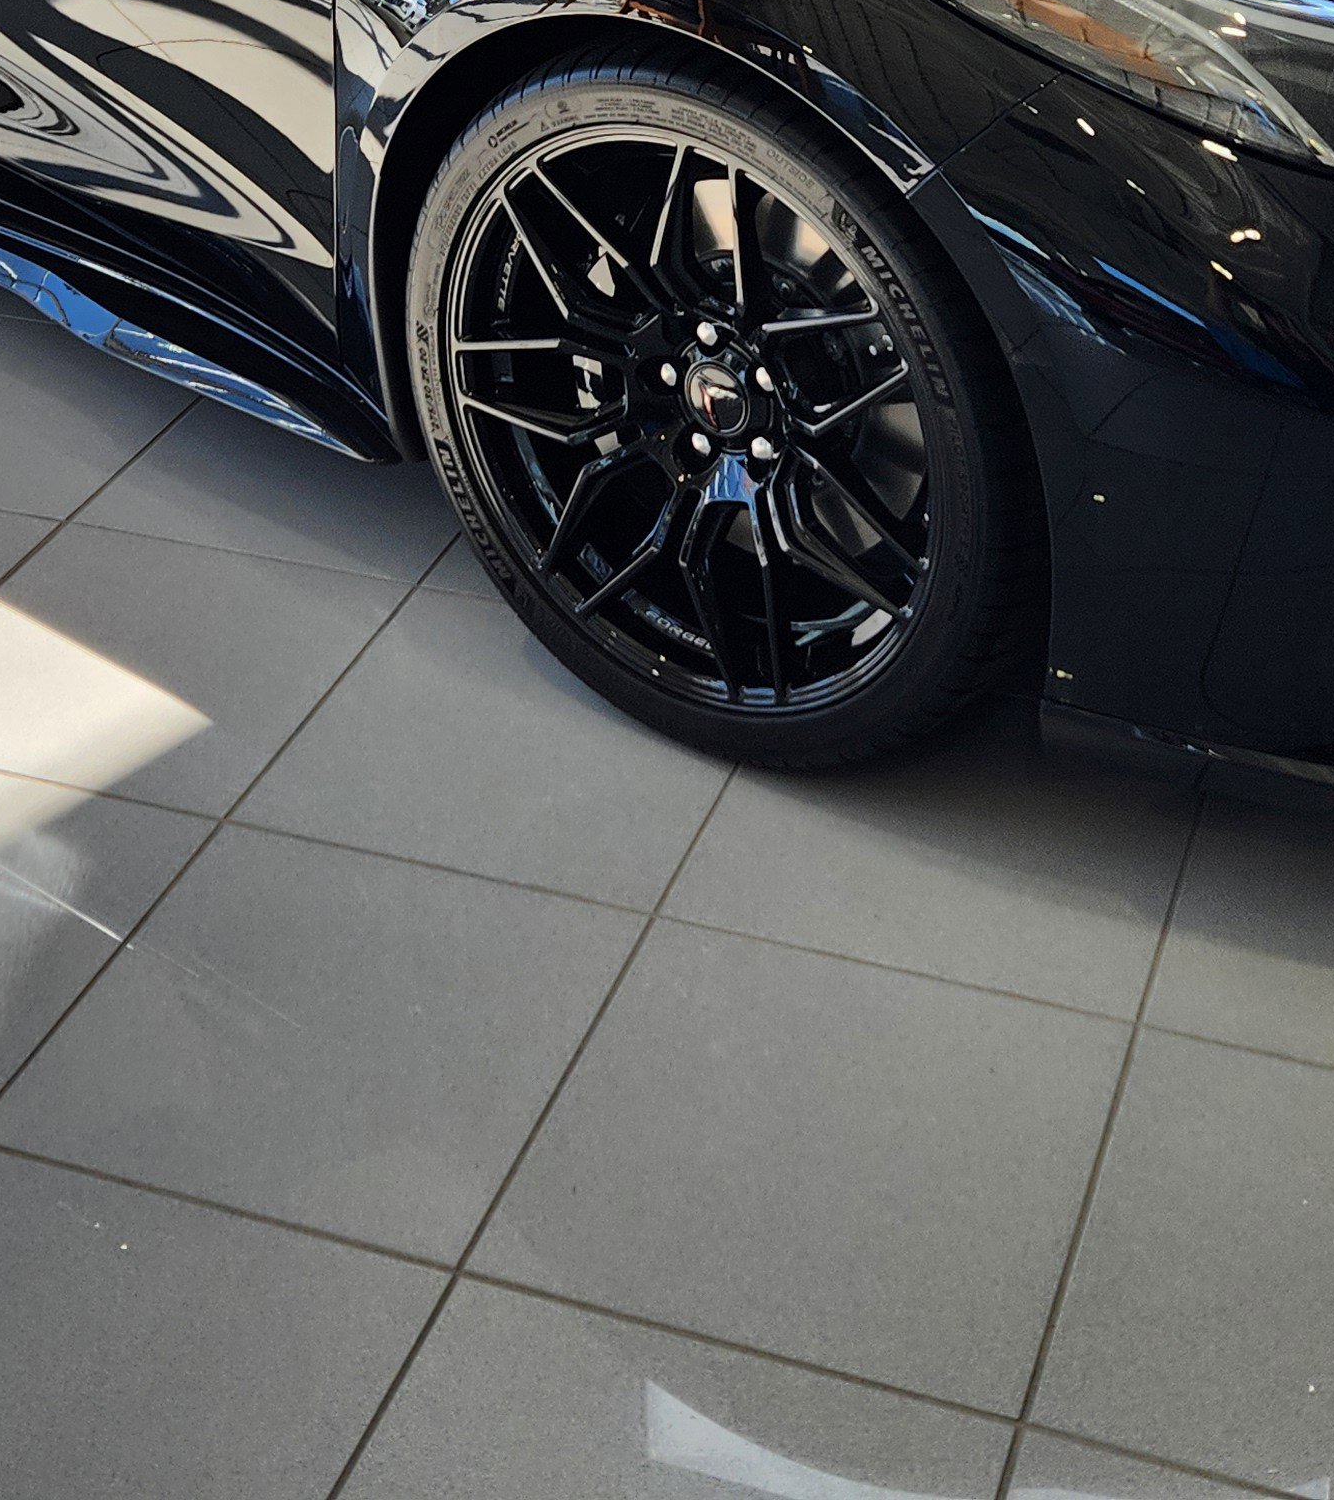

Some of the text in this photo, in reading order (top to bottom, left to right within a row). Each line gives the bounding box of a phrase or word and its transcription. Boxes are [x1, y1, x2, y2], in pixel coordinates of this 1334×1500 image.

[765, 147, 816, 190] OUTSIDE
[497, 232, 523, 313] ORVETTE
[860, 244, 950, 397] MICHELIN
[437, 448, 512, 580] MICHELIN
